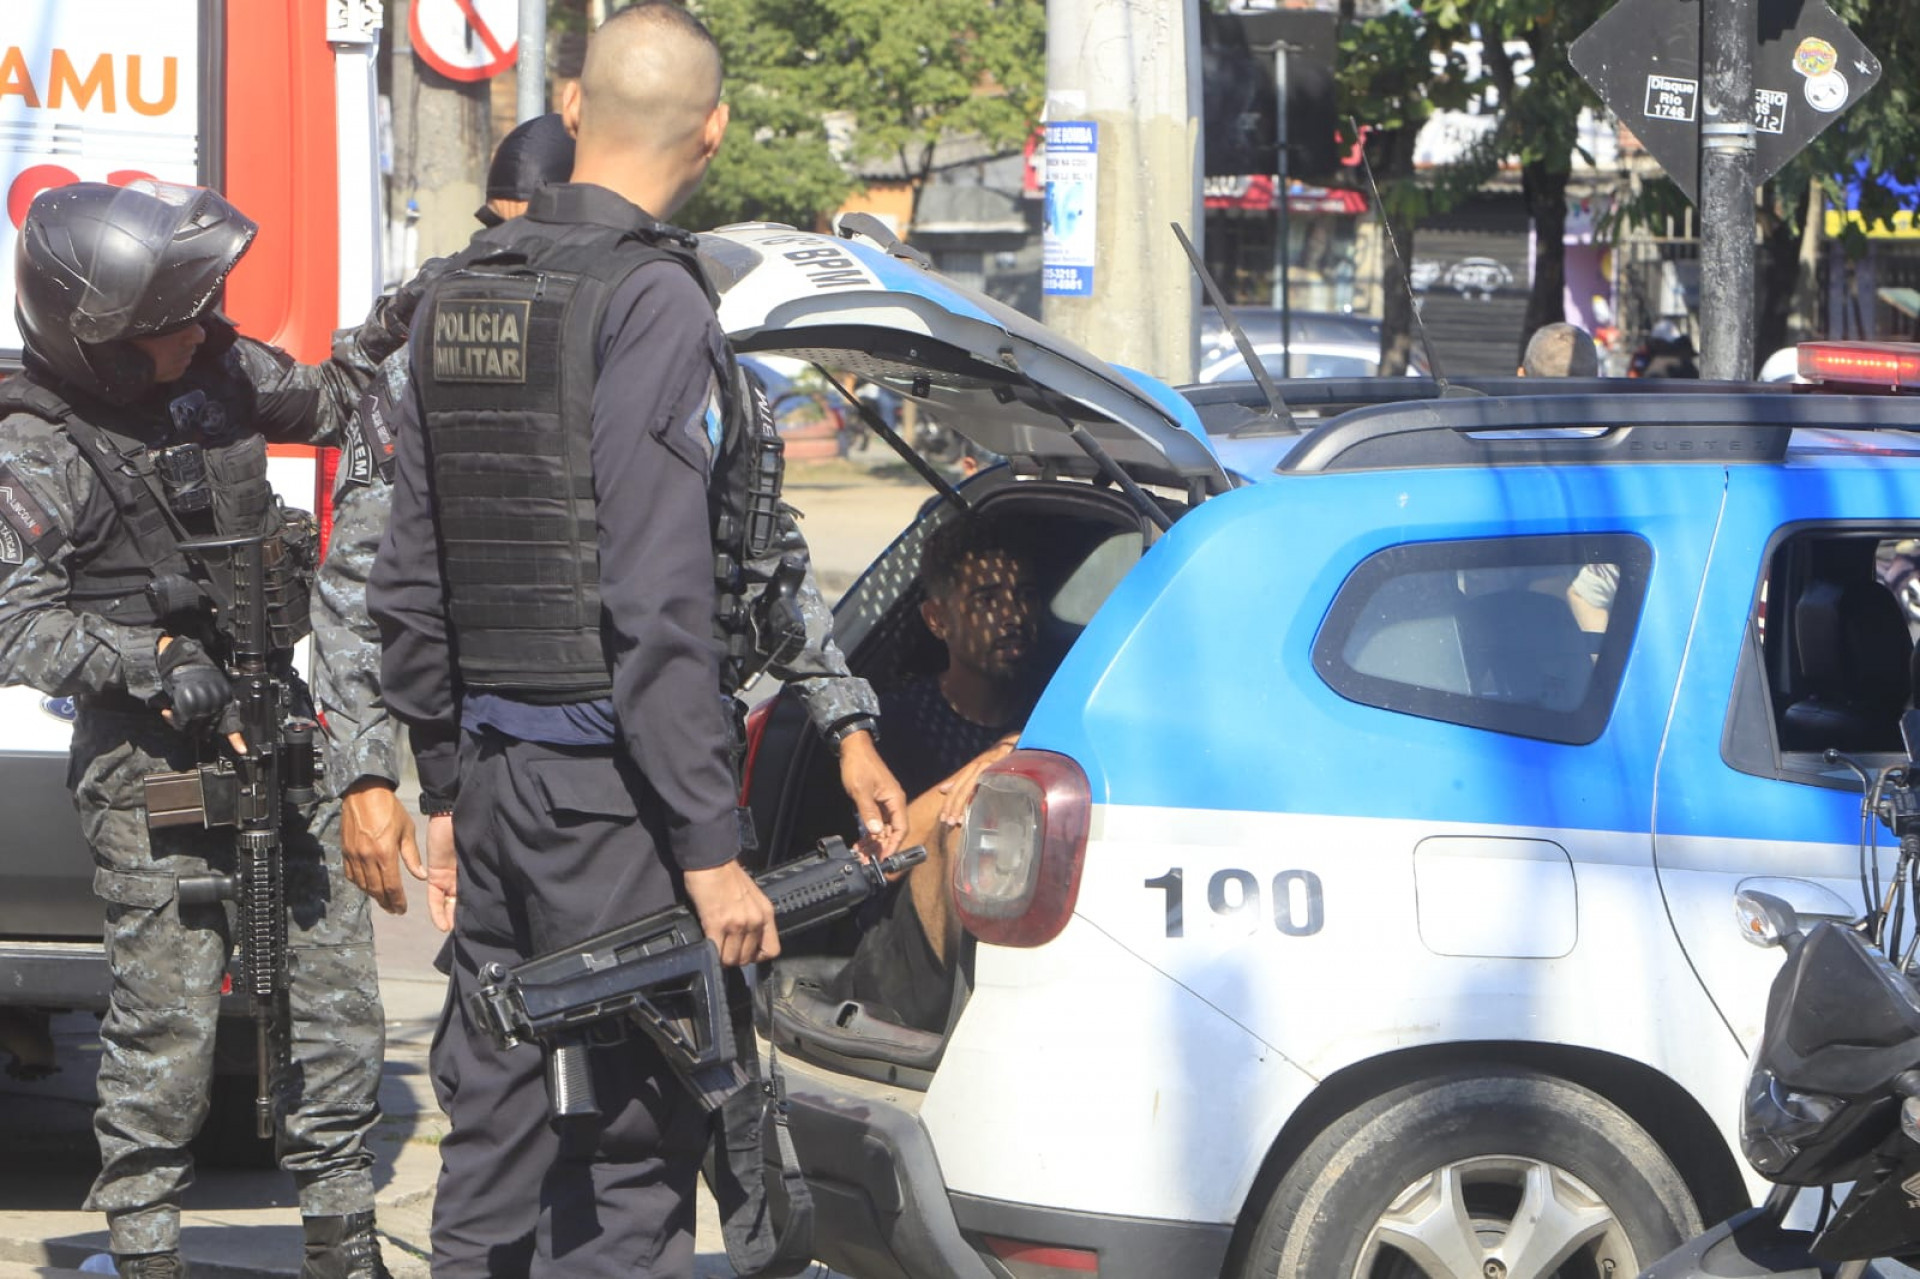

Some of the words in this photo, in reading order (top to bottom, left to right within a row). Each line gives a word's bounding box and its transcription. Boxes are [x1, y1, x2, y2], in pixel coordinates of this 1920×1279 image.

[1651, 78, 1694, 95] Disque
[1660, 92, 1682, 106] Rio
[1655, 104, 1686, 118] 1746
[783, 247, 870, 289] BPM
[436, 305, 520, 343] POLÍCIA
[436, 347, 521, 376] MILITAR
[1145, 867, 1325, 938] 190
